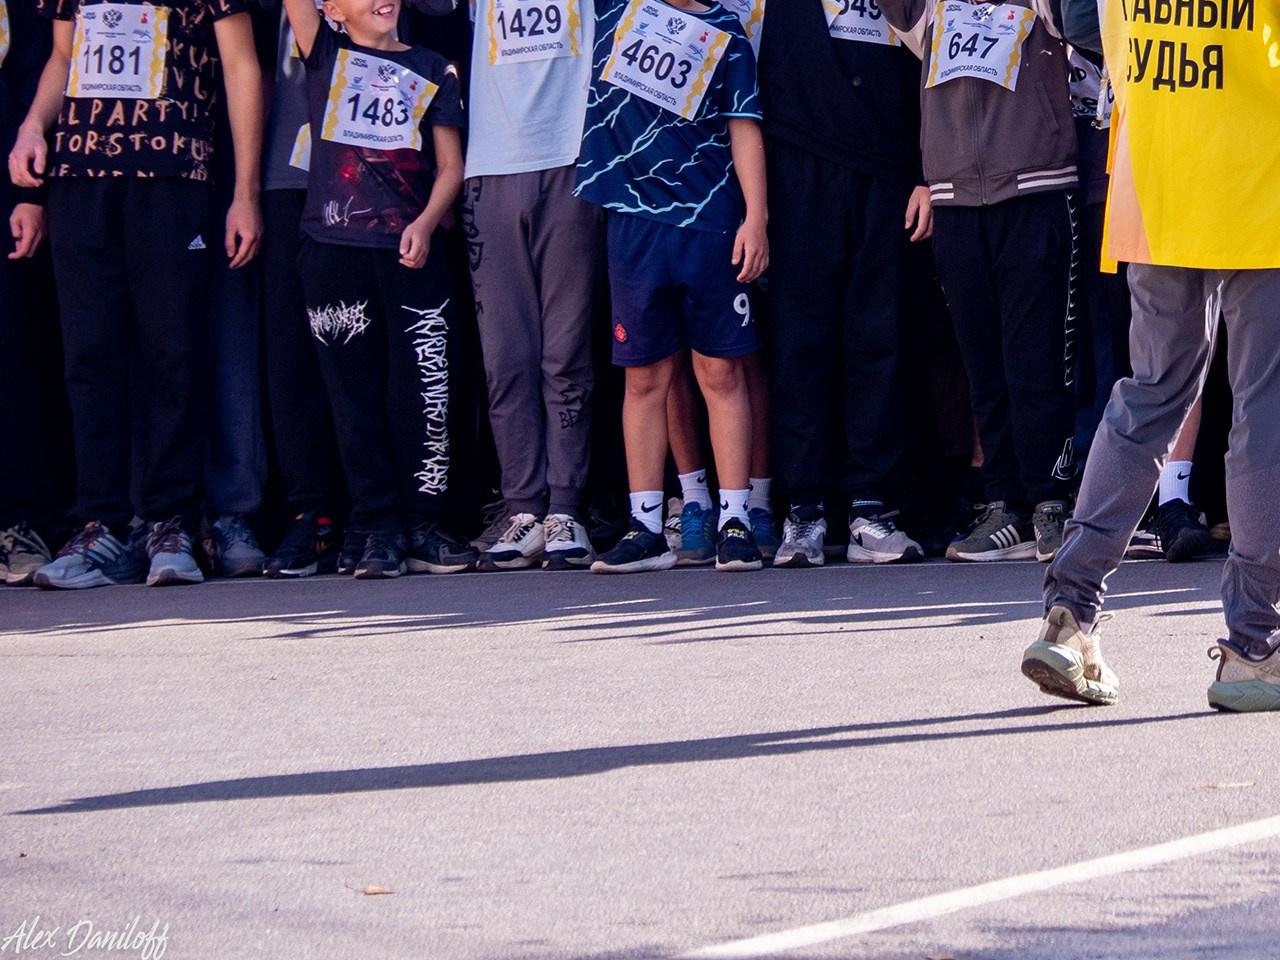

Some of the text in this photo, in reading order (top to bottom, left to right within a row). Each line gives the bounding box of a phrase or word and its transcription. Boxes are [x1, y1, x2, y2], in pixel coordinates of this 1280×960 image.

[497, 5, 561, 40] 1429
[83, 44, 141, 75] 1181
[948, 32, 1000, 60] 647
[621, 38, 692, 89] 4603
[348, 93, 410, 127] 1483
[653, 90, 677, 106] ОБЛАСТЬ
[733, 293, 750, 327] 9
